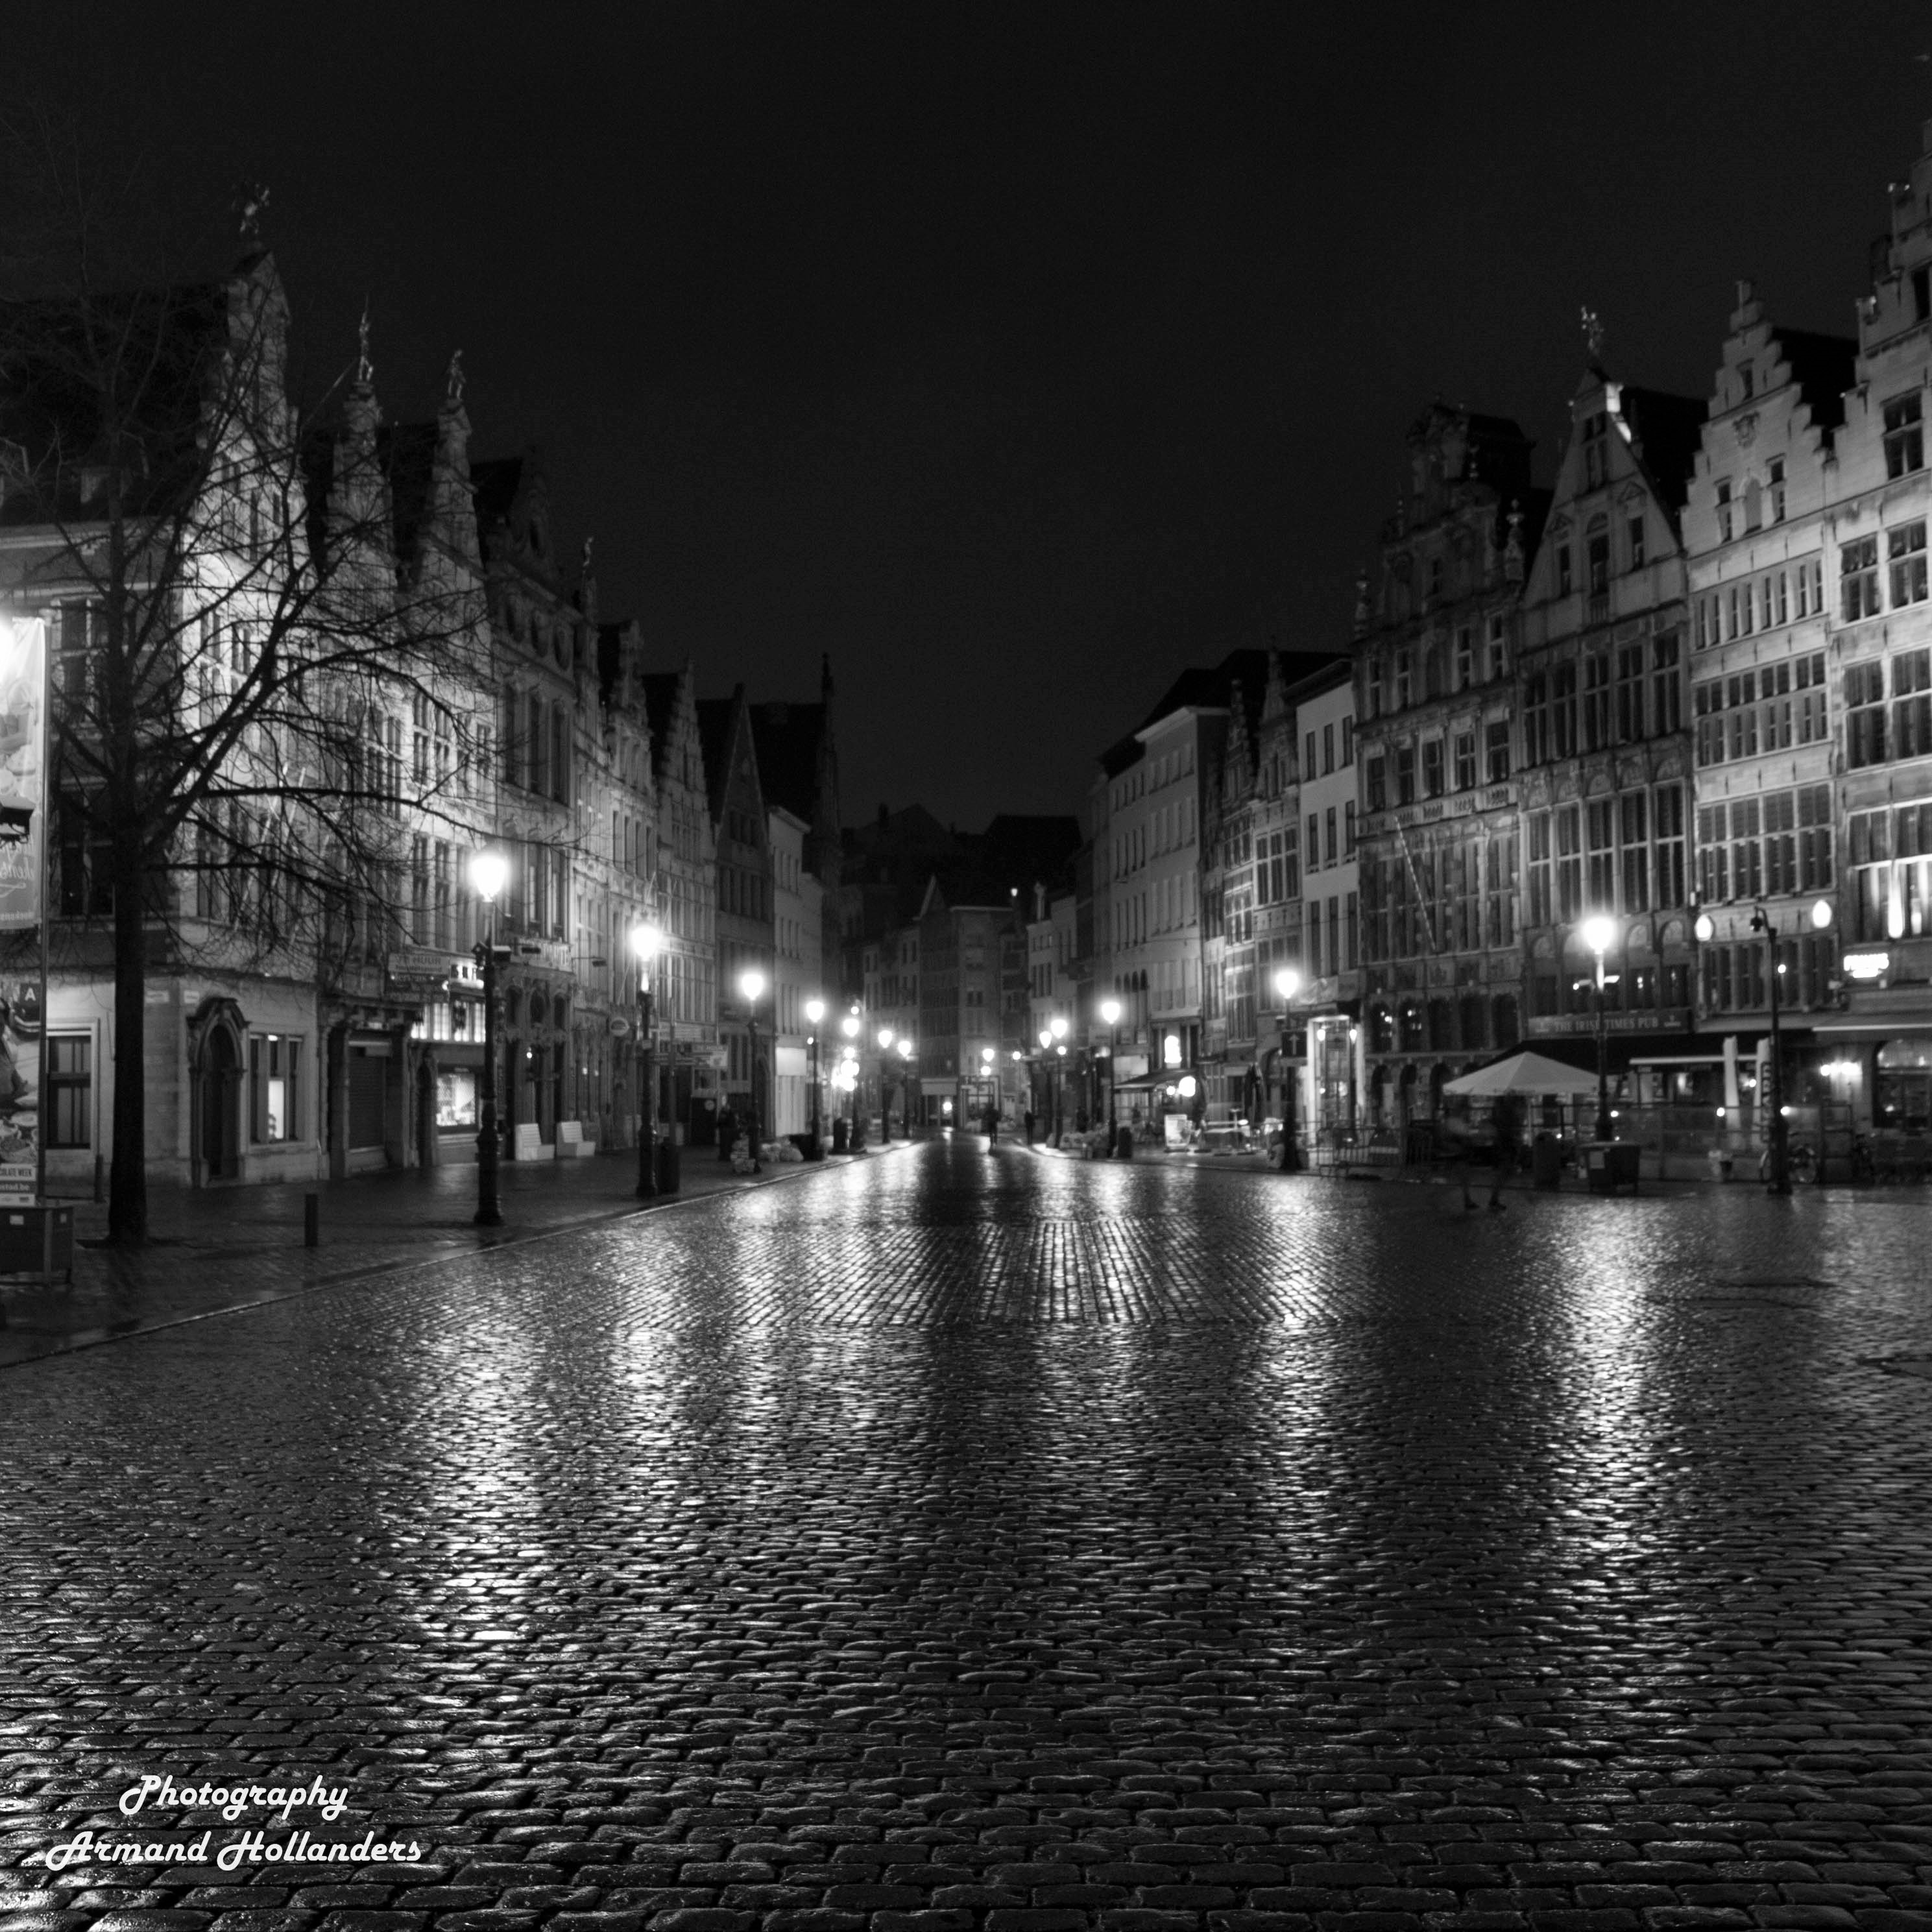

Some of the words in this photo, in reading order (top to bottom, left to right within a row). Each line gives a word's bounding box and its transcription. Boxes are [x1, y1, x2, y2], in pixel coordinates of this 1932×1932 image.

[25, 987, 36, 1001] A
[1554, 1020, 1573, 1032] THE
[1604, 1017, 1634, 1030] TIMES
[1638, 1016, 1659, 1028] PUB
